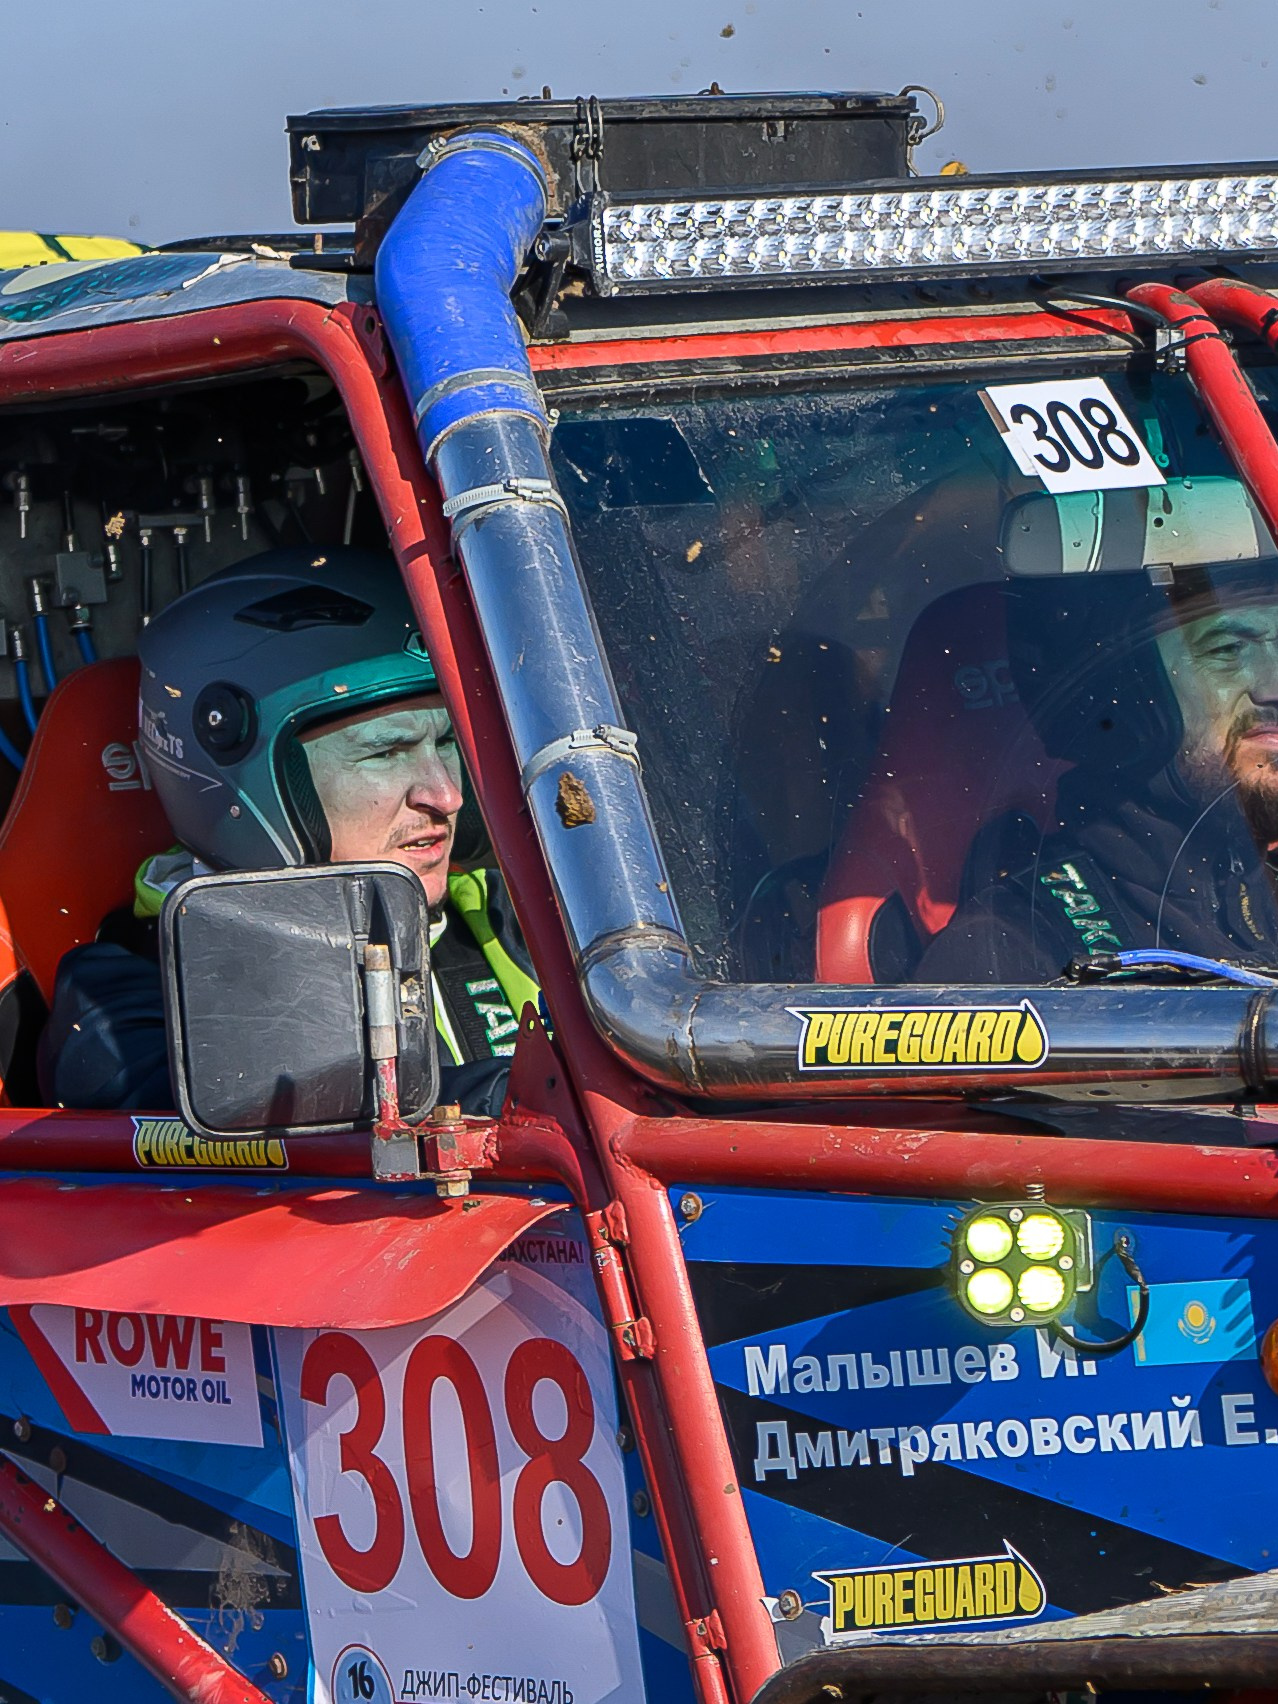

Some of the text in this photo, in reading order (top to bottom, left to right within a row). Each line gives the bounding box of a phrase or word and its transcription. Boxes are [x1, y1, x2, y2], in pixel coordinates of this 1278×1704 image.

[1010, 397, 1141, 473] 308
[806, 1011, 1022, 1064] PUREGUARD
[74, 1306, 227, 1374] ROWE
[743, 1343, 1019, 1397] Малышев
[130, 1373, 232, 1405] MOTOR OIL
[300, 1331, 612, 1606] 308
[753, 1395, 1204, 1482] Дмитряковский
[829, 1560, 1016, 1630] PUREGUARD
[347, 1660, 375, 1699] 16
[400, 1669, 575, 1704] ДЖИП-ФЕСТИВАЛЬ
